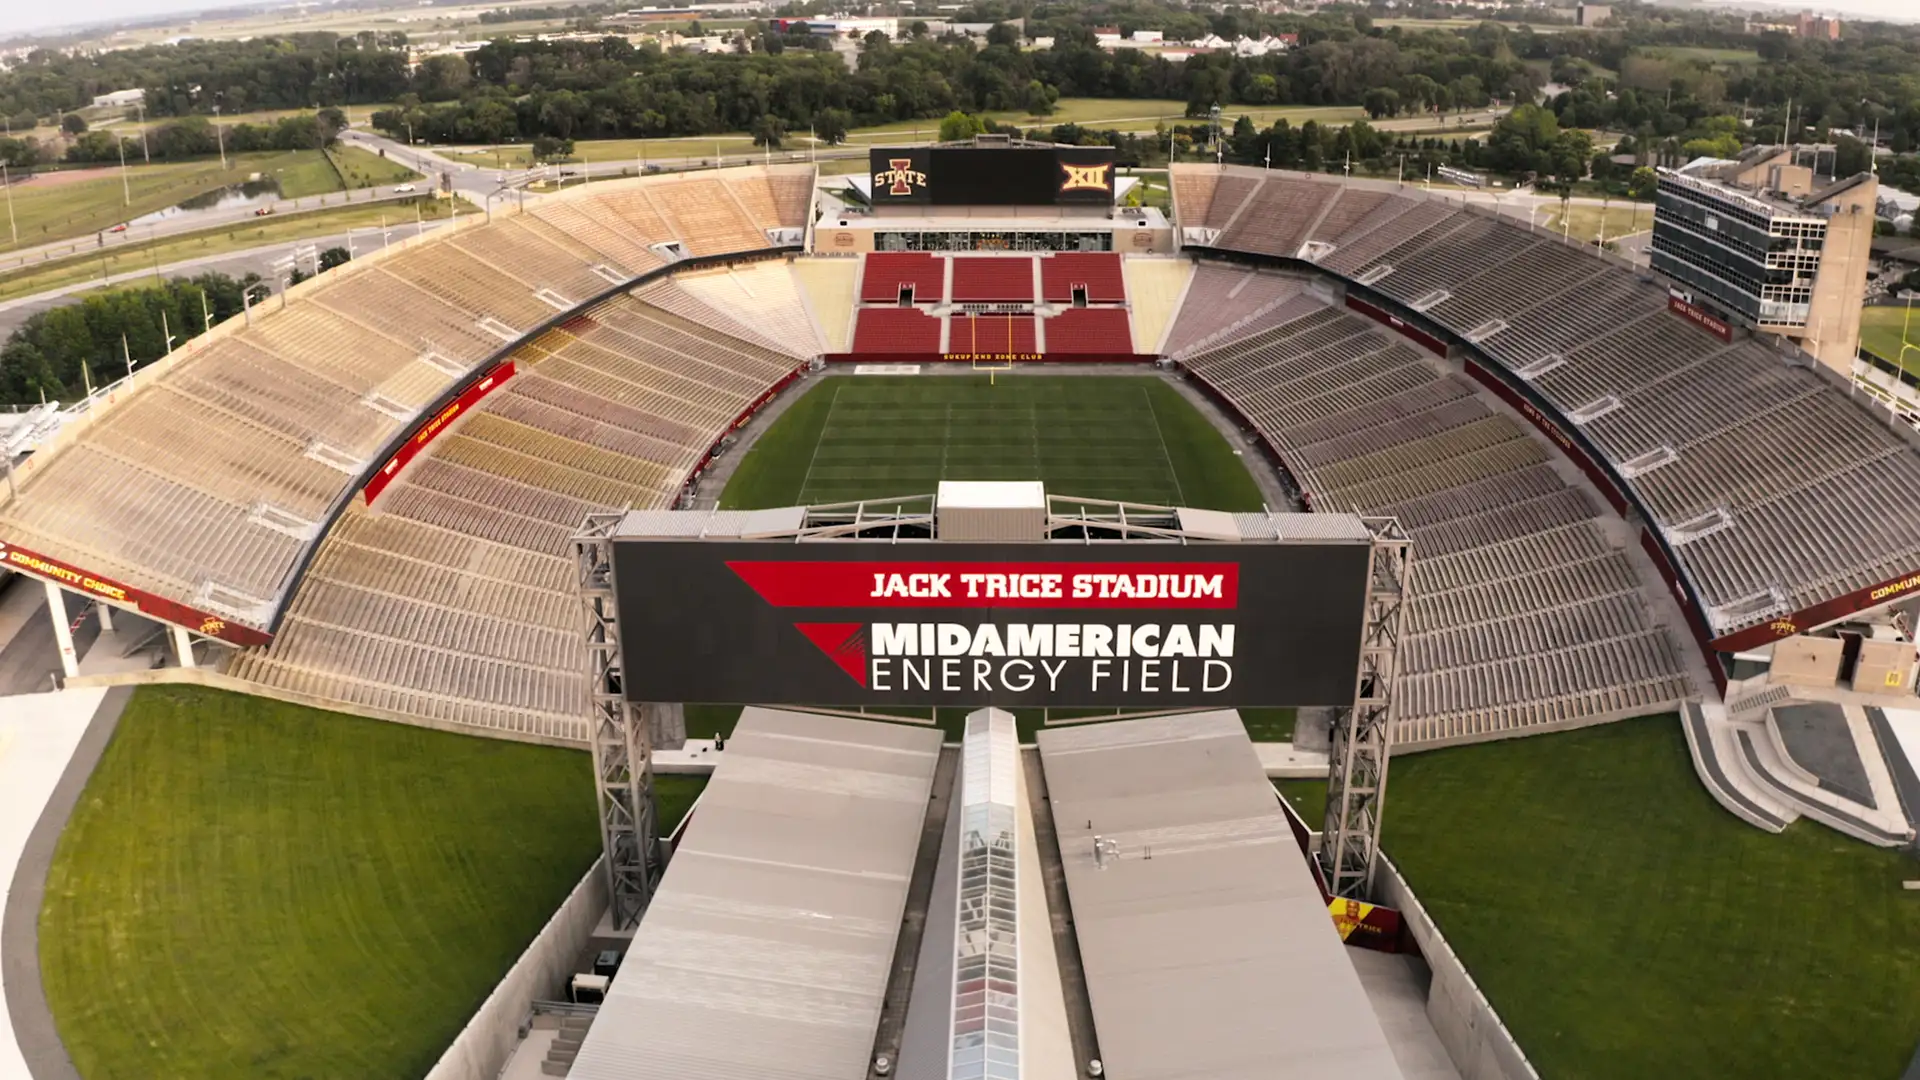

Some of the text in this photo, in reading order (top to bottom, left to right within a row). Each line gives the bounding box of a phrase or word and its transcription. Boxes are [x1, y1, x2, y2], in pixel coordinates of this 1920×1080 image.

[874, 170, 927, 187] STATE
[1061, 163, 1110, 191] XII
[10, 551, 126, 599] COMMUNITY CHOICE
[870, 573, 1224, 599] JACK TRICE STADIUM
[200, 621, 226, 633] STATE
[871, 622, 1236, 658] MIDAMERICAN
[1770, 621, 1797, 633] STATE
[872, 658, 1233, 692] ENERGY FIELD
